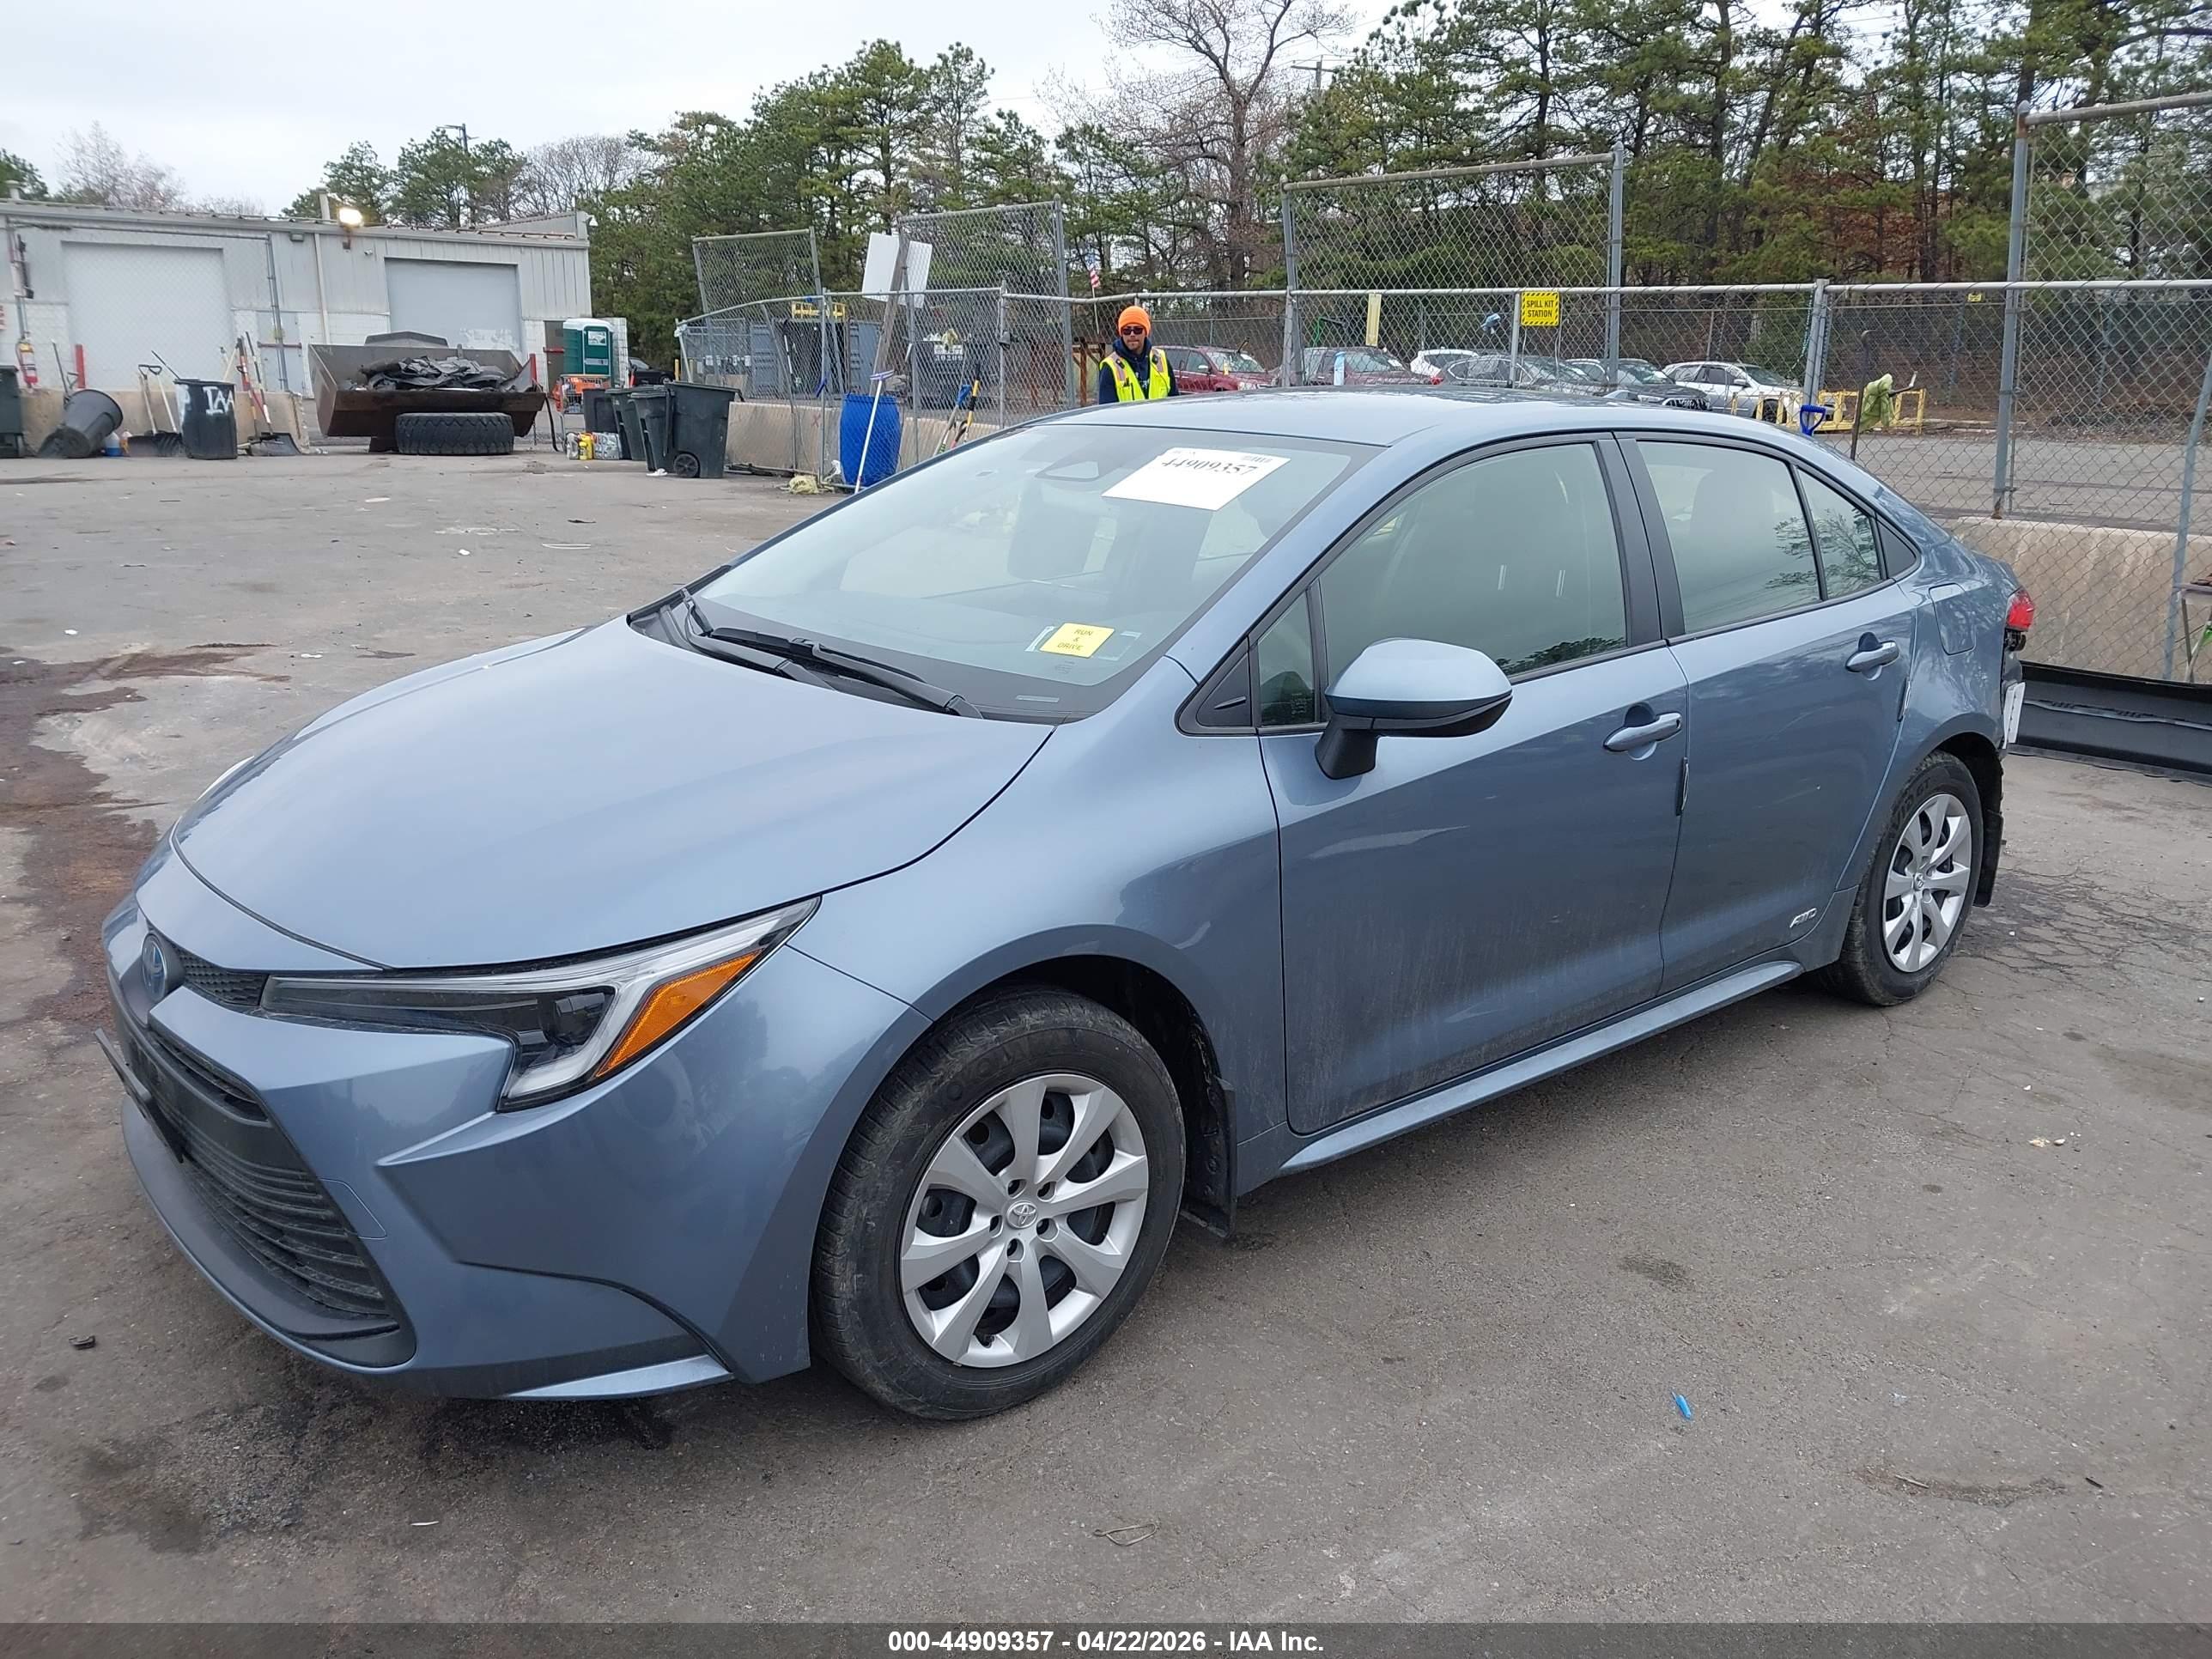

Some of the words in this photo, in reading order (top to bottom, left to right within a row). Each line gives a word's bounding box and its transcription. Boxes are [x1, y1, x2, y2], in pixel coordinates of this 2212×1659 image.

[1526, 300, 1543, 308] SPILL
[1544, 300, 1554, 308] KIT
[1527, 309, 1553, 318] STATION
[1161, 458, 1260, 475] 44909357
[1073, 628, 1094, 636] RUN
[1057, 641, 1084, 652] DRIVE
